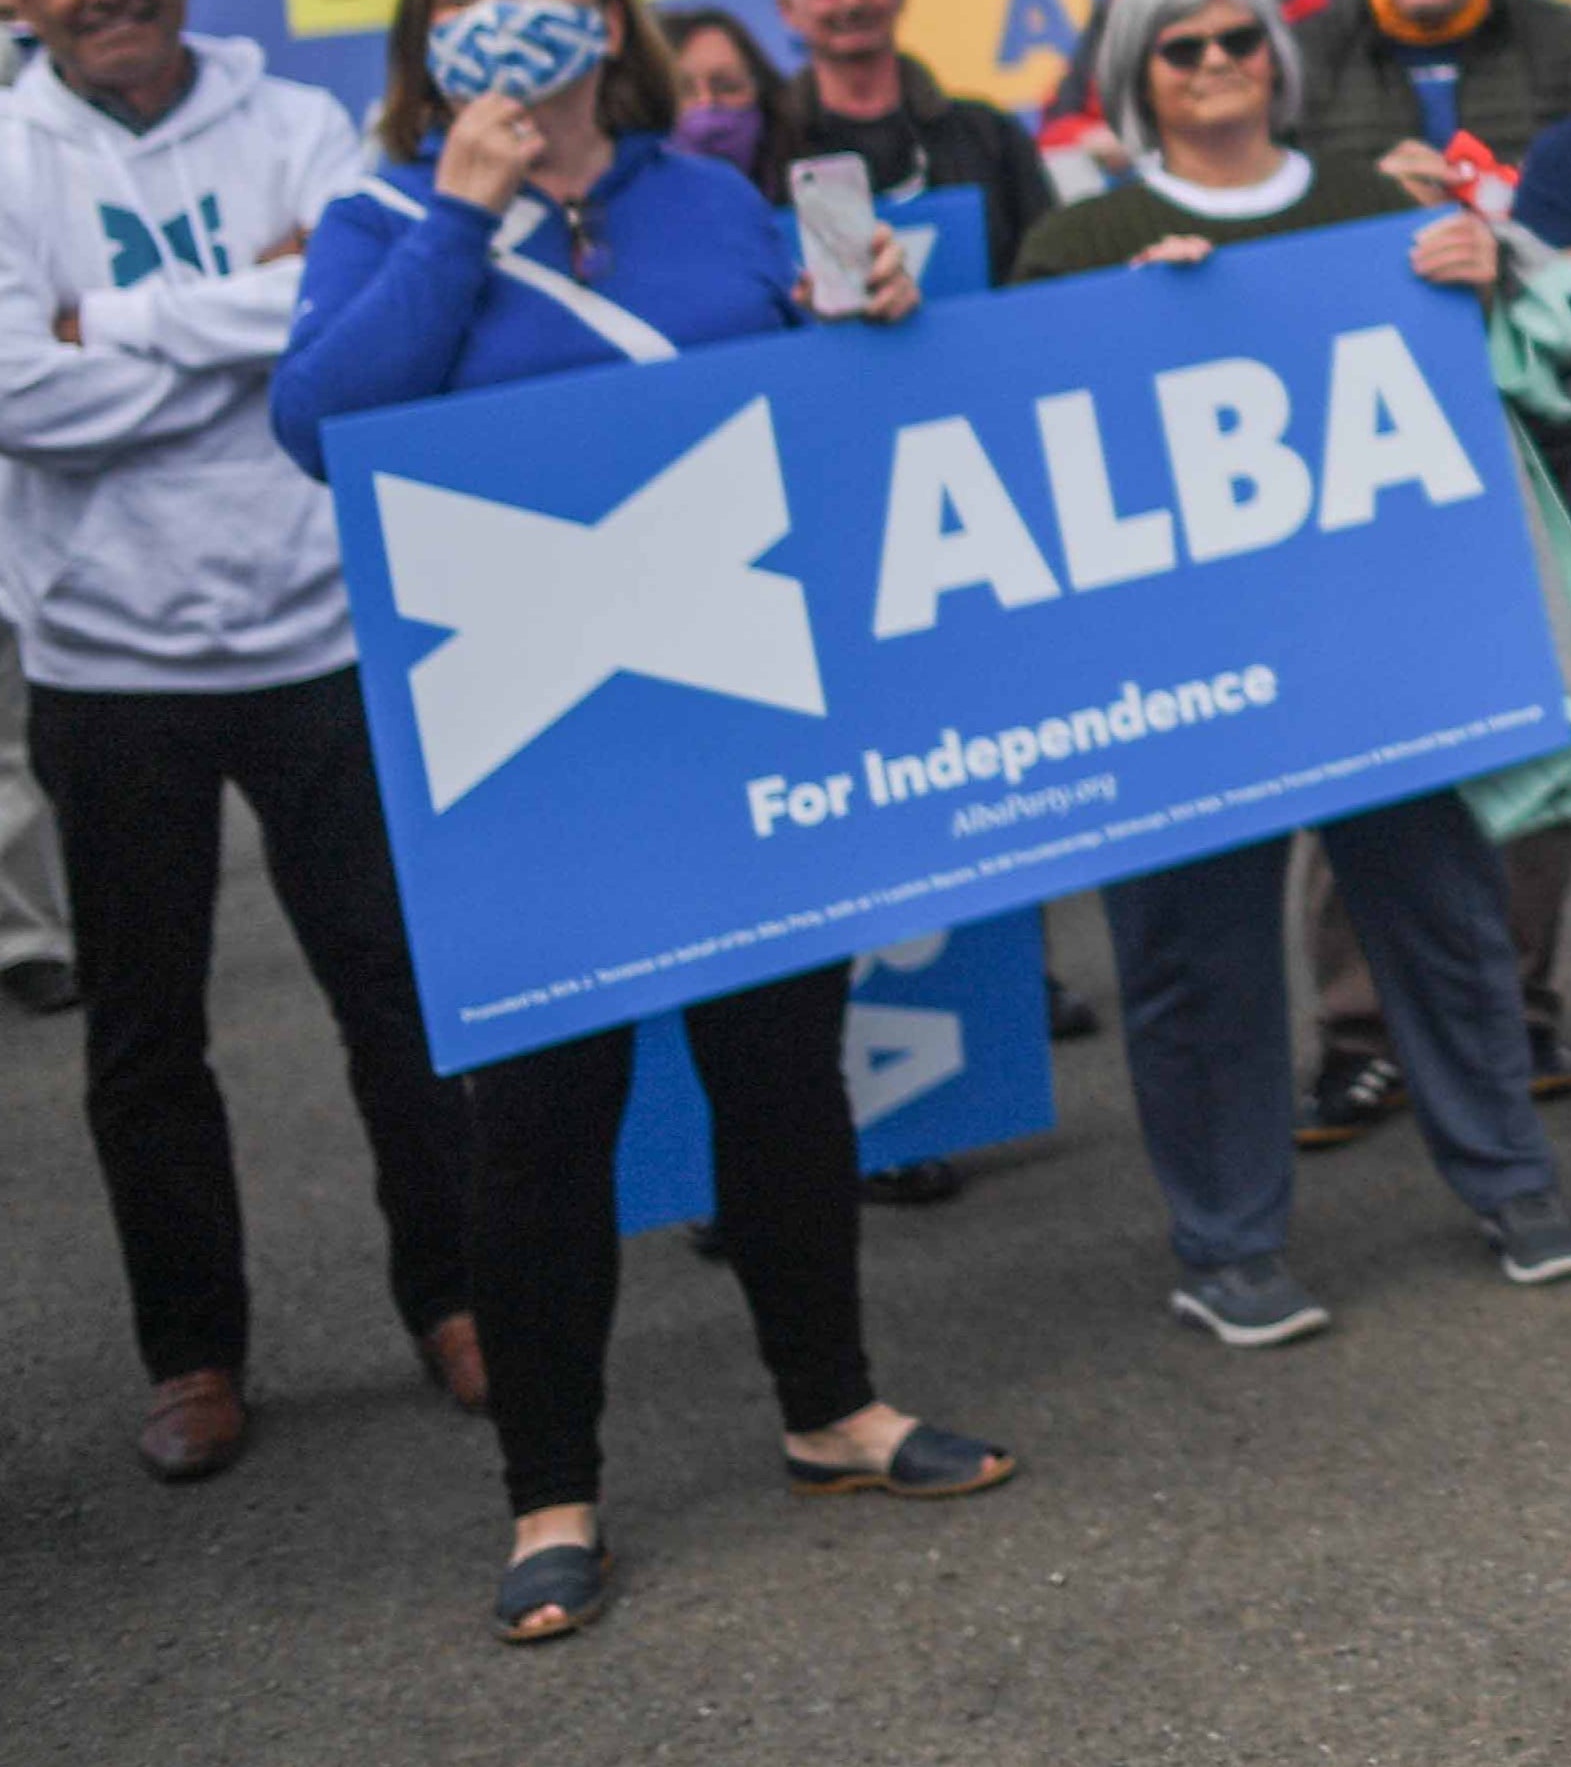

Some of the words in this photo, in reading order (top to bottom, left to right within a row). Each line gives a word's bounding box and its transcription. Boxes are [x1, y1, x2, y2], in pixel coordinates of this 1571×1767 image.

[874, 324, 1486, 639] ALBA
[746, 774, 854, 839] For
[863, 663, 1278, 808] Independence
[951, 772, 1119, 839] AlbaParty.org
